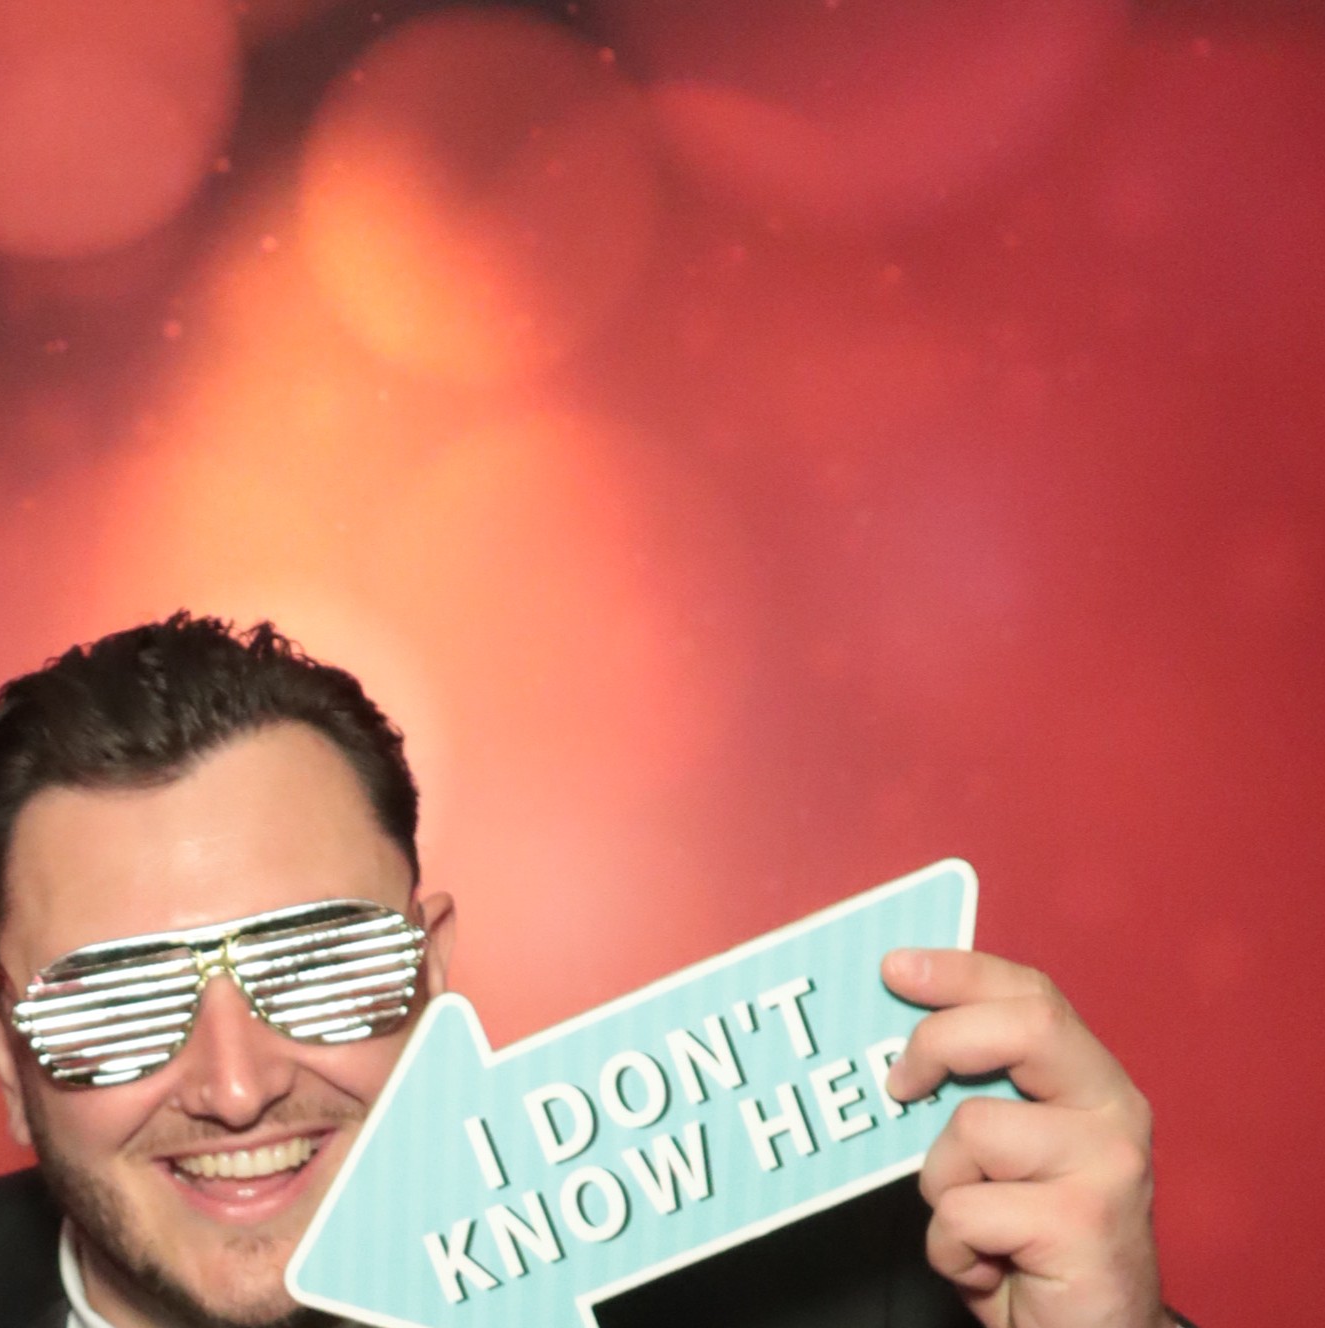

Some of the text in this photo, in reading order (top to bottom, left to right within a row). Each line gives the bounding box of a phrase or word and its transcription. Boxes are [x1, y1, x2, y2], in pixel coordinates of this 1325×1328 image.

[462, 975, 819, 1191] I DON'T
[422, 1117, 716, 1306] KNOW
